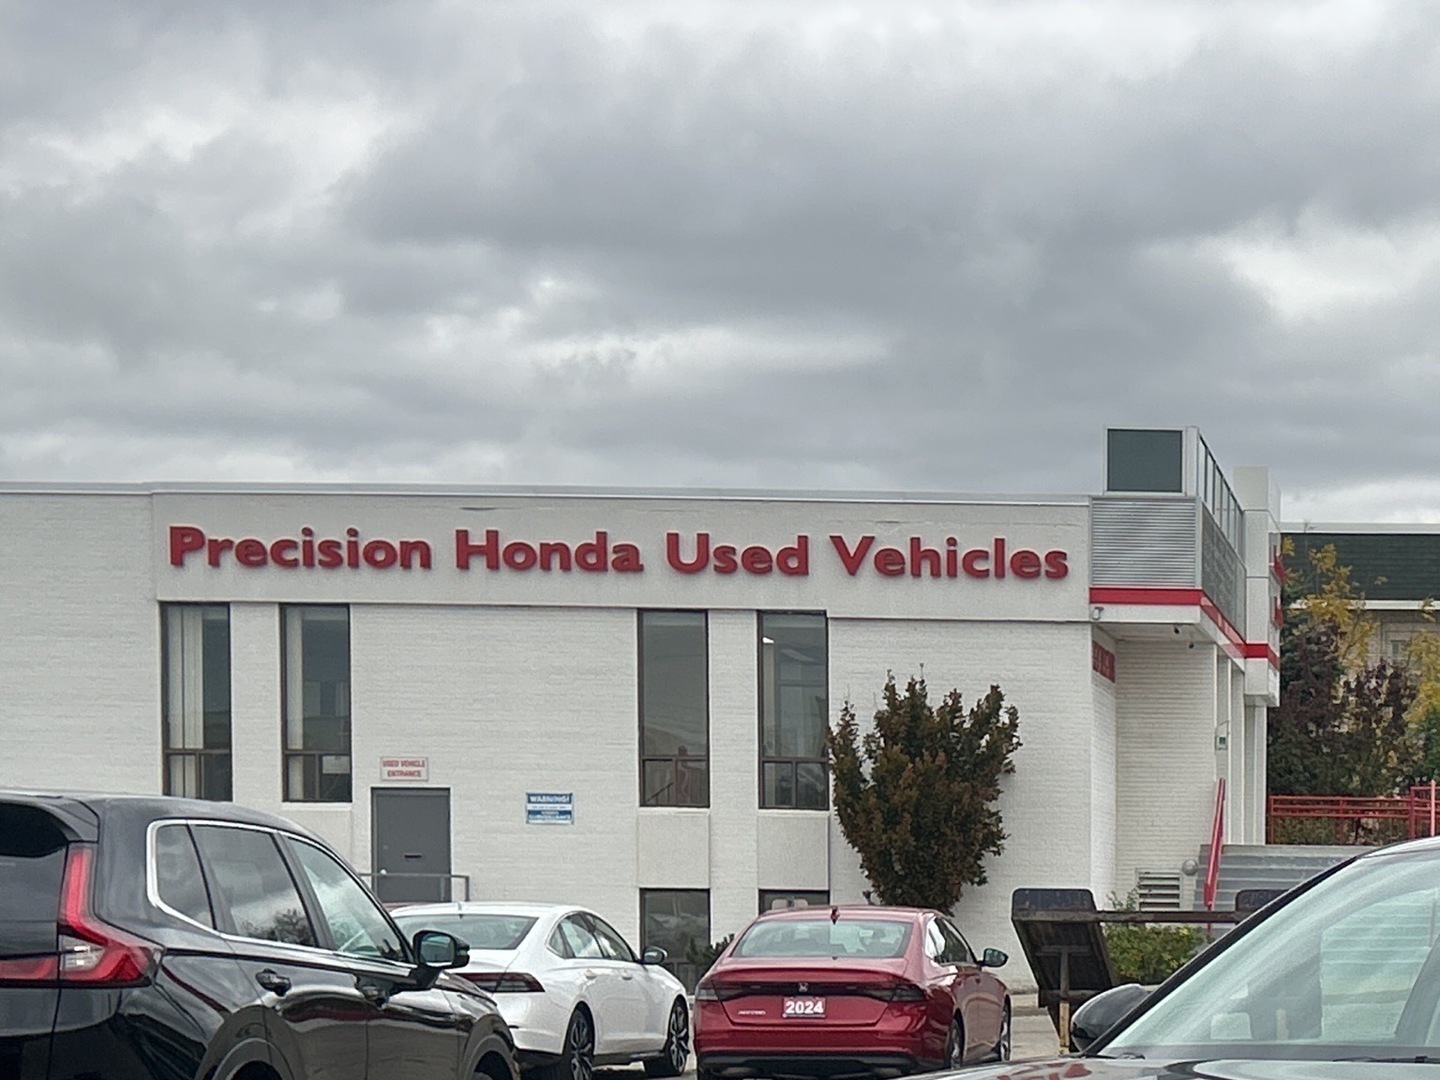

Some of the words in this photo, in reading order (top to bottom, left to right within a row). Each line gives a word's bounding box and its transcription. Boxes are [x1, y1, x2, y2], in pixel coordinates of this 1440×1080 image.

[169, 526, 431, 569] Precision
[455, 529, 644, 572] Honda
[666, 532, 809, 576] Used
[829, 535, 1069, 579] Vehicles
[785, 1001, 824, 1014] 2024
